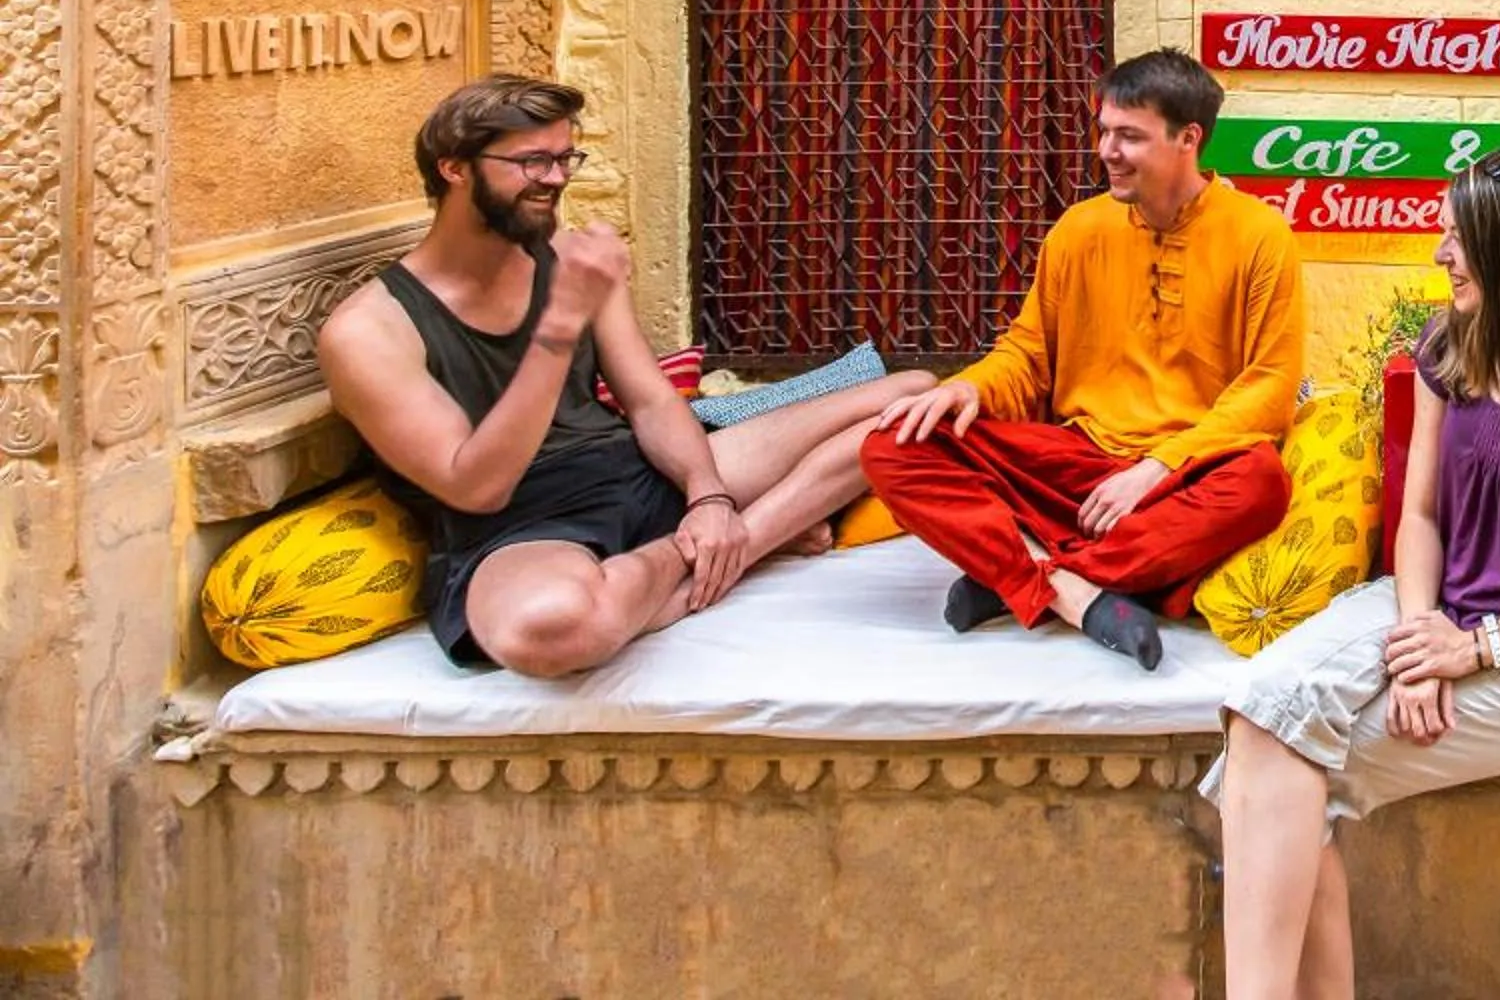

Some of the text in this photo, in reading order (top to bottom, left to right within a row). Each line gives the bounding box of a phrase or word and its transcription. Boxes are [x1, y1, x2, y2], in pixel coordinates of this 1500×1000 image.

[1217, 14, 1368, 70] Movie
[1252, 125, 1489, 177] Cafe &
